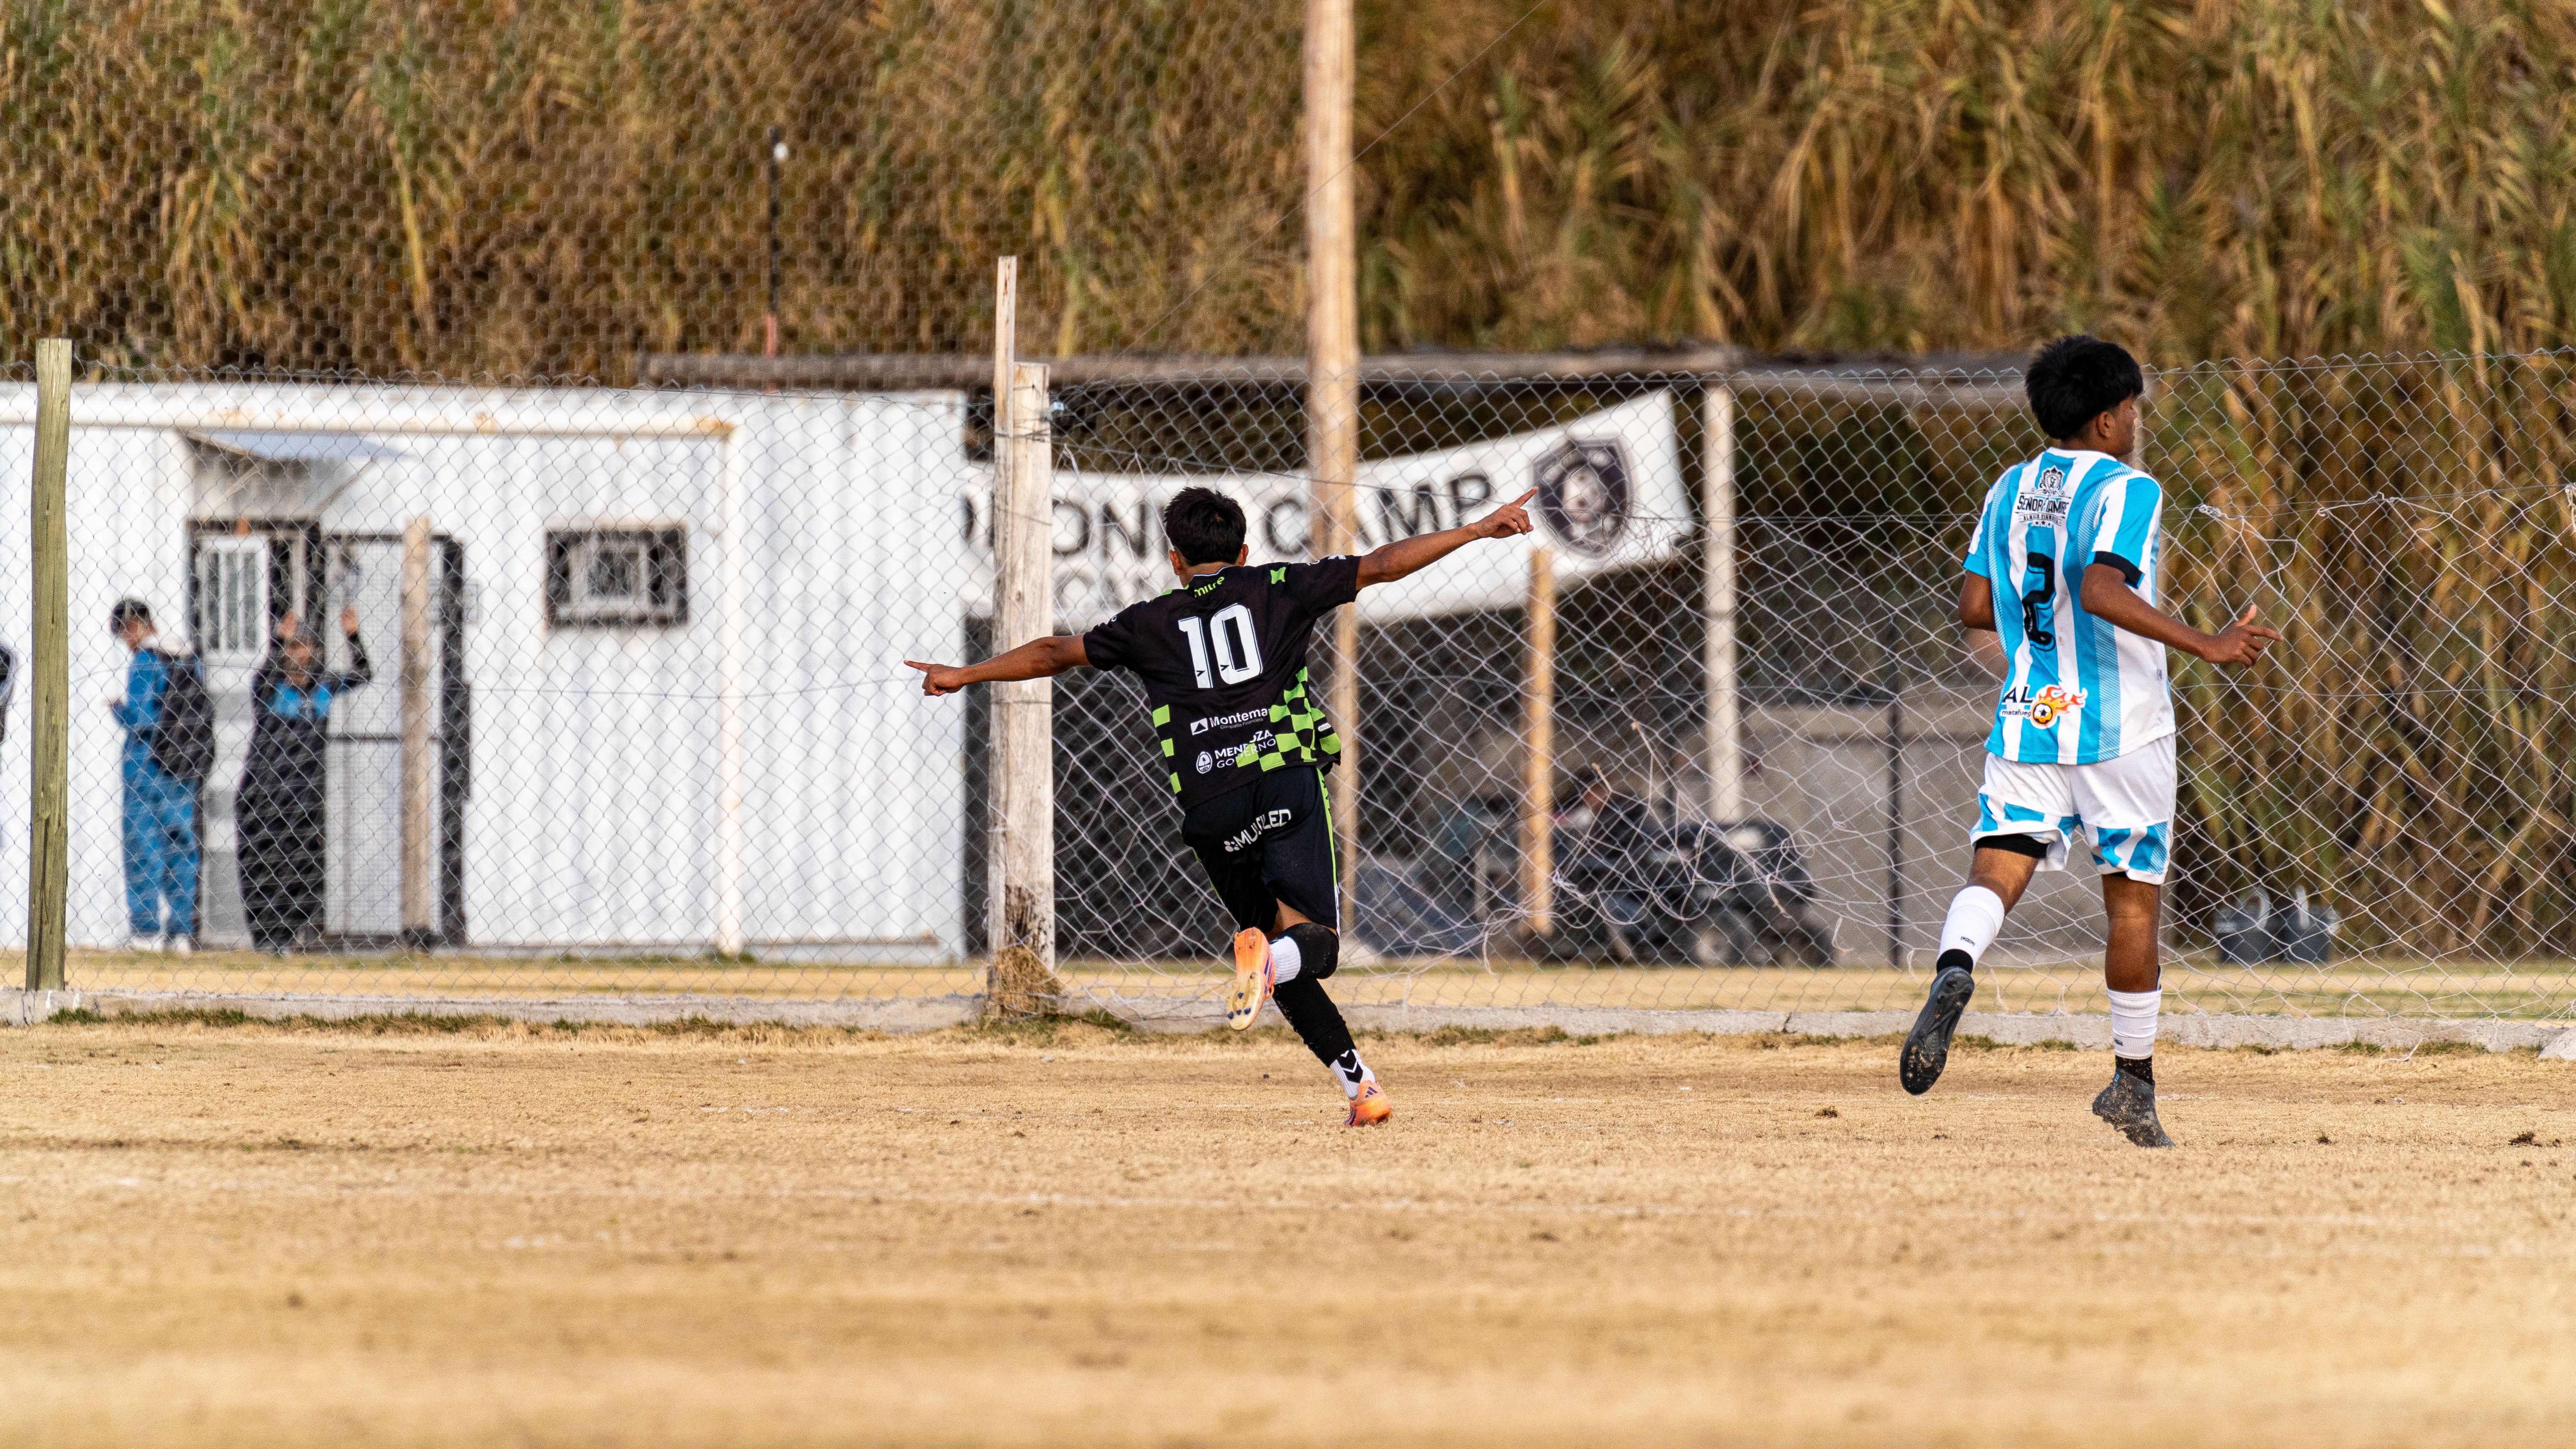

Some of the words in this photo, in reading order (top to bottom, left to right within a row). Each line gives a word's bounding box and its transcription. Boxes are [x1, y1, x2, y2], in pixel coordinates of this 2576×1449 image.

[2022, 552, 2057, 652] 2
[1178, 603, 1263, 688] 10
[1209, 708, 1270, 727] Montema
[2002, 686, 2033, 703] AL
